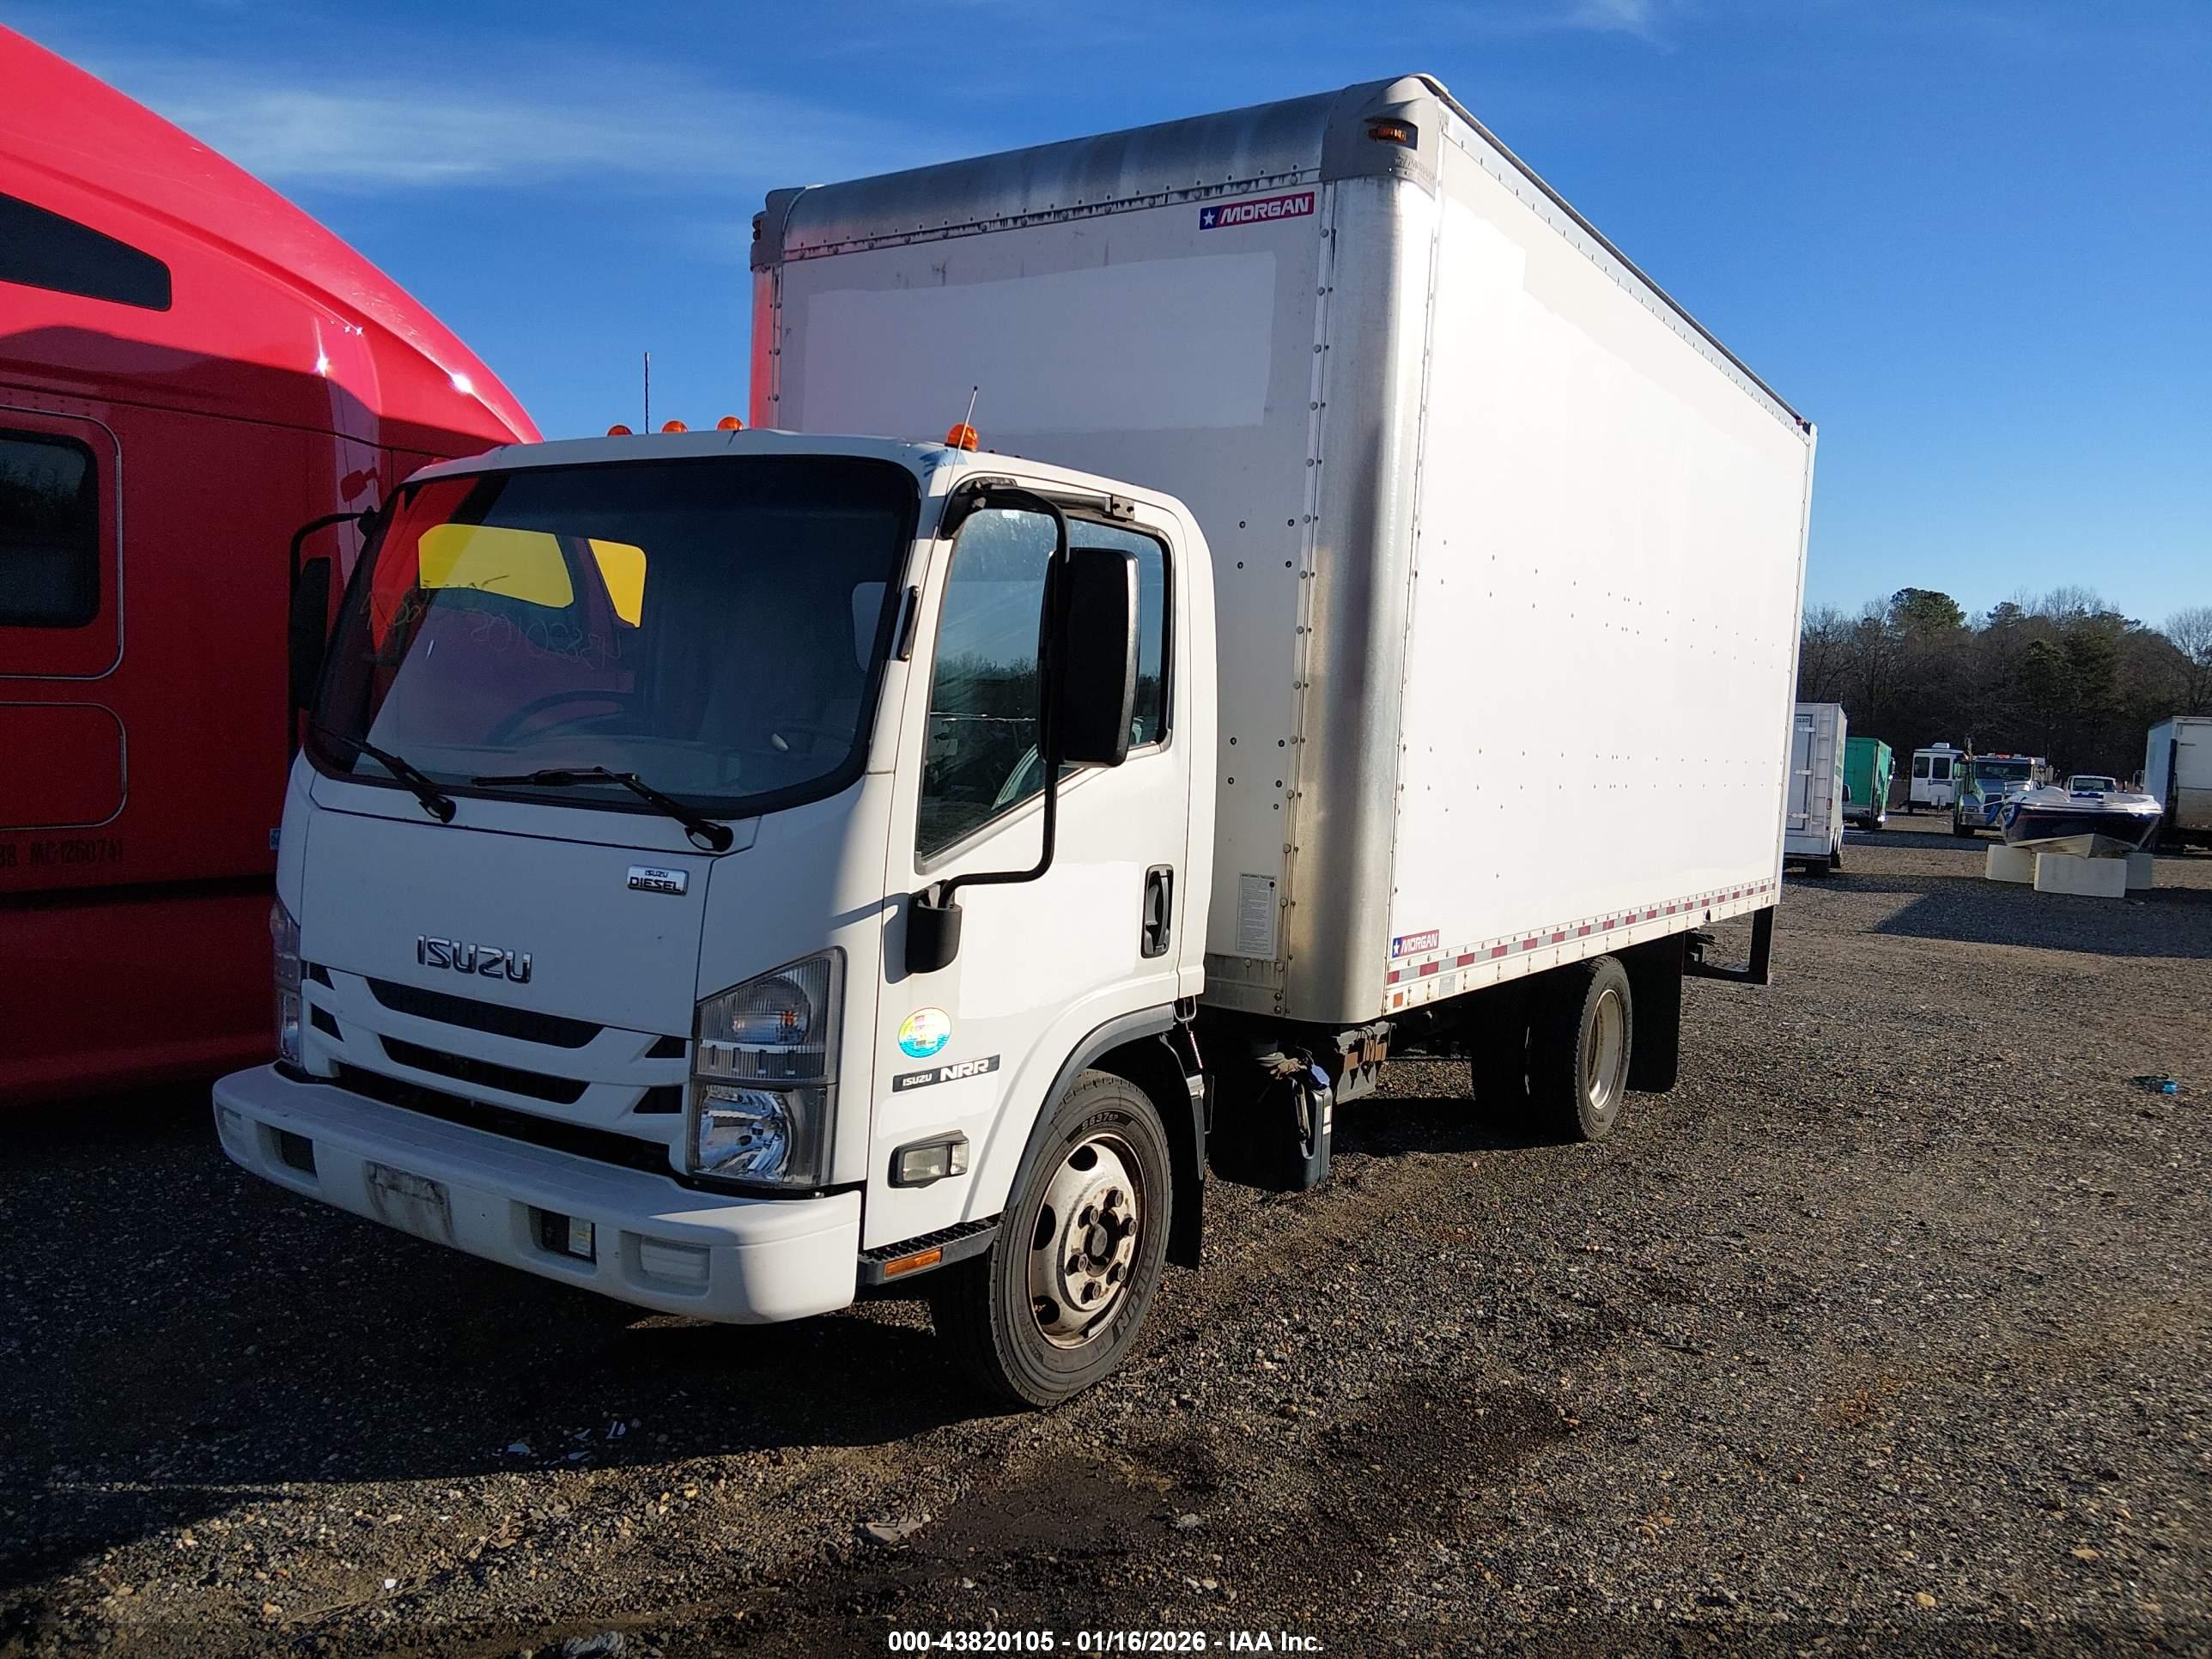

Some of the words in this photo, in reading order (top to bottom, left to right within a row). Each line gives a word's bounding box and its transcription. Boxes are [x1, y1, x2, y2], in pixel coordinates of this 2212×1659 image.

[1220, 196, 1309, 224] MORGAN
[629, 876, 683, 892] DIESEL
[644, 869, 669, 878] ISUZU
[1401, 933, 1439, 954] MORGAN
[416, 934, 533, 984] ISUZU
[902, 1073, 933, 1086] ISUZU
[939, 1059, 989, 1082] NRR
